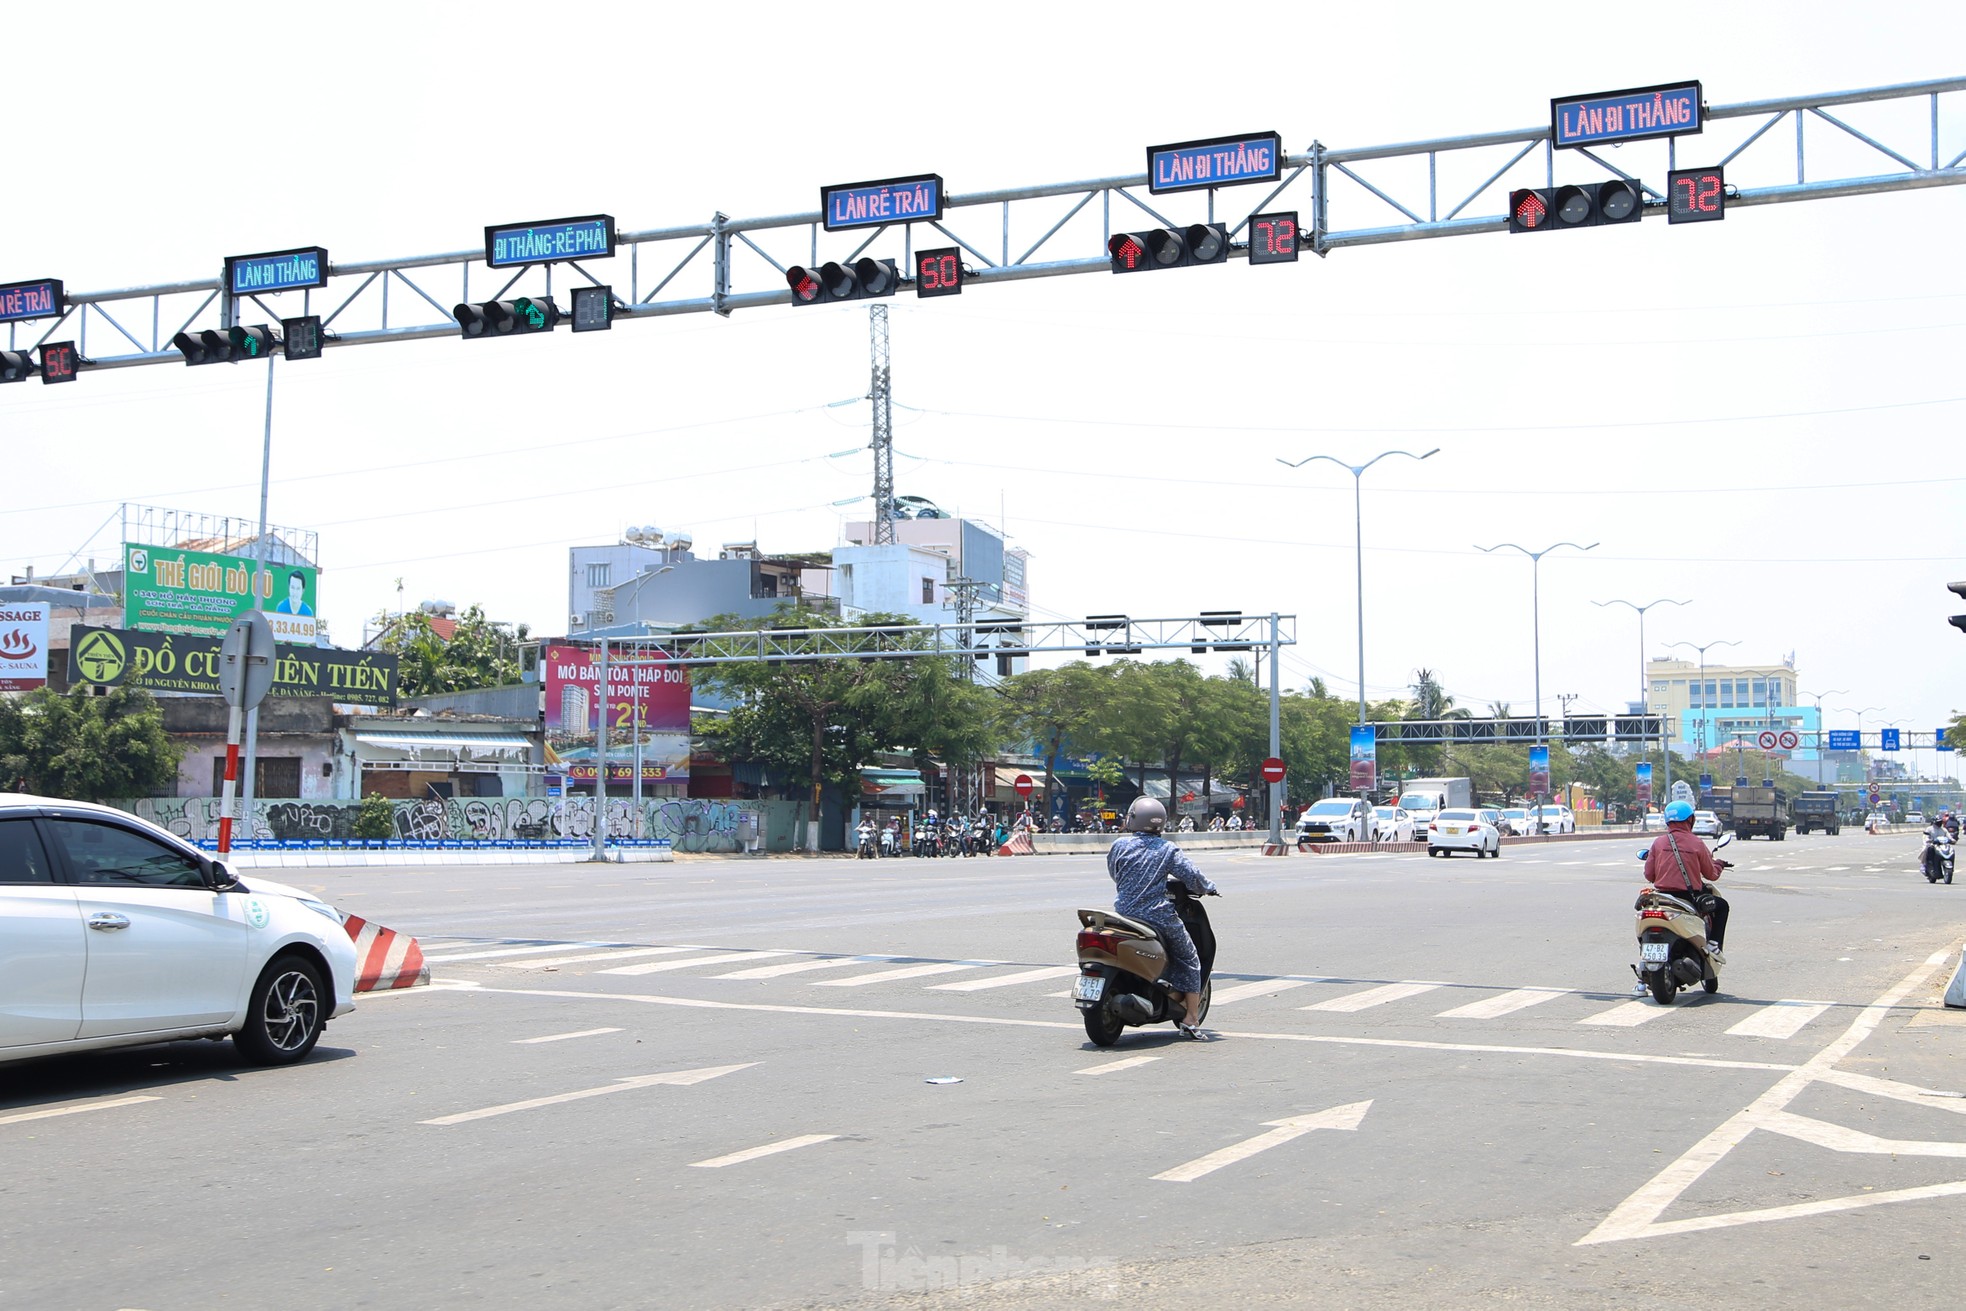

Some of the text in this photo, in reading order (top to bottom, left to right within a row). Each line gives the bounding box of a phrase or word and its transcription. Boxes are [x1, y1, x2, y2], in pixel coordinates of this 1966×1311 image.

[1564, 103, 1603, 138] LÀN
[1605, 105, 1624, 134] ĐI
[1159, 153, 1193, 184] LÀN
[1195, 155, 1211, 179] ĐI
[836, 193, 867, 221] LÀN
[893, 184, 929, 214] TRÁI
[1676, 174, 1721, 212] 72
[494, 238, 507, 260] ĐI
[1257, 220, 1296, 254] 72
[237, 261, 262, 288] LÀN
[262, 264, 275, 285] ĐI
[920, 254, 957, 289] 50
[24, 286, 52, 312] TRÁI
[154, 555, 185, 588] THẾ
[188, 561, 223, 592] GIỚI
[225, 560, 248, 595] ĐỒ
[8, 662, 38, 670] SAUNA
[134, 636, 177, 675] ĐỒ
[273, 653, 320, 686] IÊN
[327, 655, 390, 691] TIẾN
[594, 685, 615, 697] SN
[616, 702, 632, 727] 2
